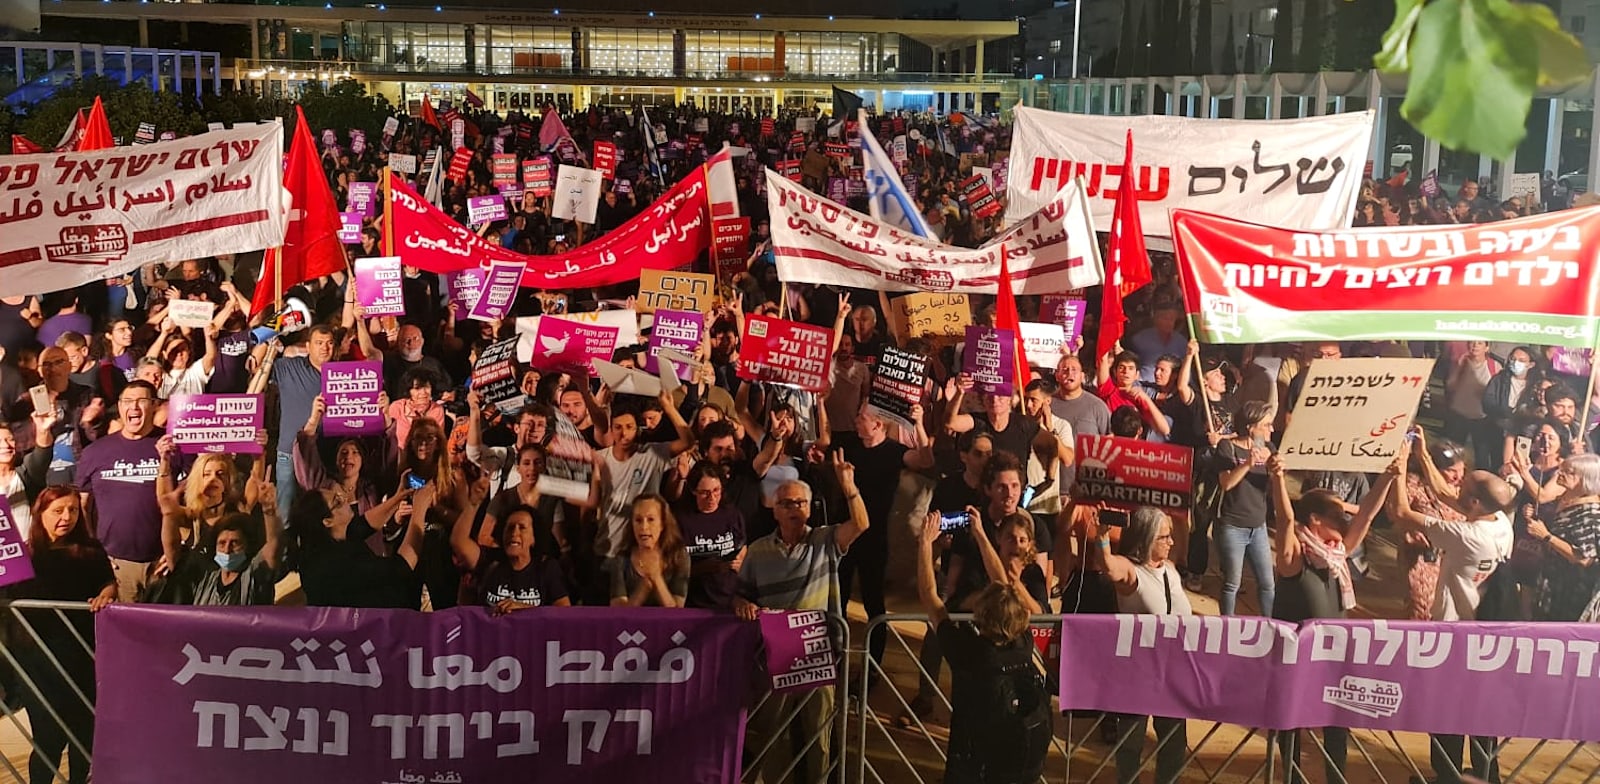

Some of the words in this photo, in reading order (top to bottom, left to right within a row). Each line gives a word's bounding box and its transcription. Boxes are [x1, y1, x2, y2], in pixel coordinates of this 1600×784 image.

[175, 139, 260, 171] שלום
[54, 151, 170, 186] ישראל
[1188, 140, 1345, 197] שלום
[1030, 156, 1170, 202] עכשיו
[186, 172, 252, 206] سلام
[0, 190, 43, 225] فل
[54, 180, 175, 221] إسرائيل
[94, 226, 125, 241] نقف
[787, 212, 888, 257] فلسطين
[1479, 225, 1583, 257] בעזה
[47, 244, 78, 256] ביחד
[82, 239, 125, 253] עומדים
[405, 230, 472, 257] لشعبين
[1291, 232, 1468, 259] ובשדרות
[1223, 261, 1341, 289] לחיות
[1345, 264, 1453, 291] רוצים
[1463, 256, 1580, 287] ילדים
[661, 276, 708, 295] חיים
[657, 328, 682, 338] הבית
[685, 331, 697, 339] זה
[790, 327, 828, 346] ביחד
[1435, 319, 1590, 339] hadash2009.org.i
[779, 336, 801, 354] על
[806, 345, 827, 360] נגן
[767, 350, 825, 374] המרחב
[882, 353, 909, 368] שלום
[909, 361, 925, 373] אין
[327, 369, 353, 381] بيتنا
[355, 368, 378, 379] هذا
[877, 364, 906, 380] מאבק
[907, 372, 923, 385] בלי
[1310, 372, 1396, 389] לשפיכות
[328, 382, 359, 391] הבית
[362, 381, 376, 389] זה
[1401, 375, 1423, 388] די
[219, 401, 254, 412] שוויון
[328, 406, 357, 415] כולנו
[360, 404, 377, 414] של
[1304, 396, 1369, 407] הדמים
[222, 416, 254, 427] لجميع
[1370, 413, 1407, 437] كفى
[175, 431, 228, 440] האזרחים
[230, 428, 253, 439] לכל
[100, 469, 124, 477] ביחד
[1079, 465, 1106, 479] STO
[1122, 465, 1187, 484] אפרטהייד
[1078, 482, 1183, 508] APARTHEID
[791, 612, 823, 626] ביחד
[800, 625, 828, 640] ضد
[1115, 614, 1300, 665] ושוויון
[807, 641, 828, 653] נגד
[1310, 619, 1454, 669] שלום
[172, 637, 384, 689] ننتصر
[407, 624, 524, 693] معًا
[545, 629, 696, 688] فقط
[790, 652, 833, 670] العنف
[1466, 633, 1600, 678] דרוש
[778, 668, 833, 687] האלימות
[1326, 689, 1354, 701] ביחד
[1370, 683, 1399, 697] نقف
[1358, 694, 1398, 706] עומדים
[192, 700, 350, 757] ננצח
[371, 709, 540, 761] ביחד
[562, 709, 653, 766] רק
[429, 771, 462, 784] نقف
